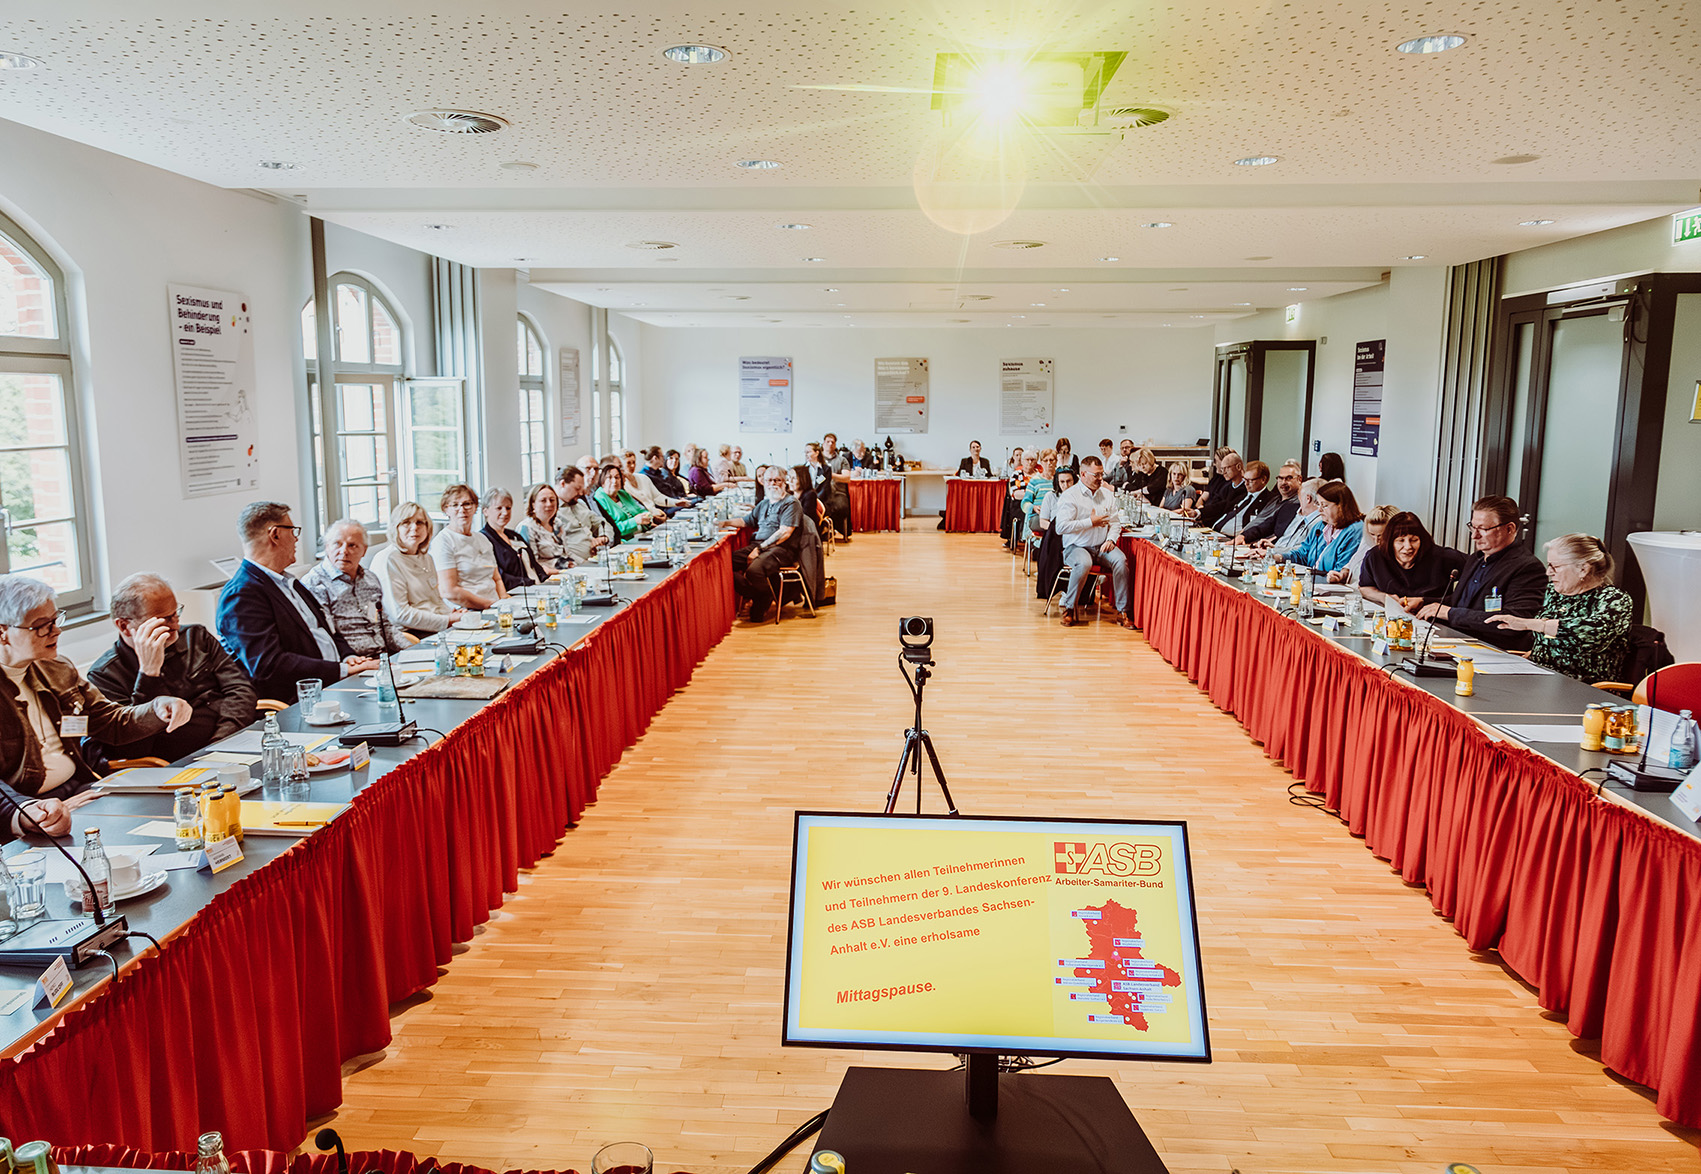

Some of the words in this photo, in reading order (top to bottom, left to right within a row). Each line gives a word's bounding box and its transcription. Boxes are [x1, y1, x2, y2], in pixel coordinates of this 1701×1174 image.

[177, 294, 209, 308] Sexismus
[211, 300, 223, 309] und
[178, 308, 220, 324] Behinderung
[184, 322, 195, 332] ein
[196, 323, 222, 336] Beispiel
[1079, 842, 1162, 877] ASB
[822, 880, 841, 890] Wir
[844, 874, 901, 887] wünschen
[904, 869, 930, 880] allen
[932, 856, 1026, 876] Teilnehmerinnen
[1055, 878, 1164, 889] Arbeiter-Samariter-Bund
[825, 900, 846, 911] und
[849, 892, 918, 908] Teilnehmern
[921, 889, 940, 899] der
[942, 886, 953, 896] 9.
[955, 874, 1052, 894] Landeskonferenz
[827, 923, 848, 933] des
[851, 918, 876, 930] ASB
[879, 906, 979, 926] Landesverbandes
[981, 899, 1035, 912] Sachsen-
[830, 942, 868, 955] Anhalt
[870, 938, 891, 949] e.V.
[893, 936, 918, 947] eine
[920, 928, 980, 943] erholsame
[836, 982, 936, 1004] Mittagspause.
